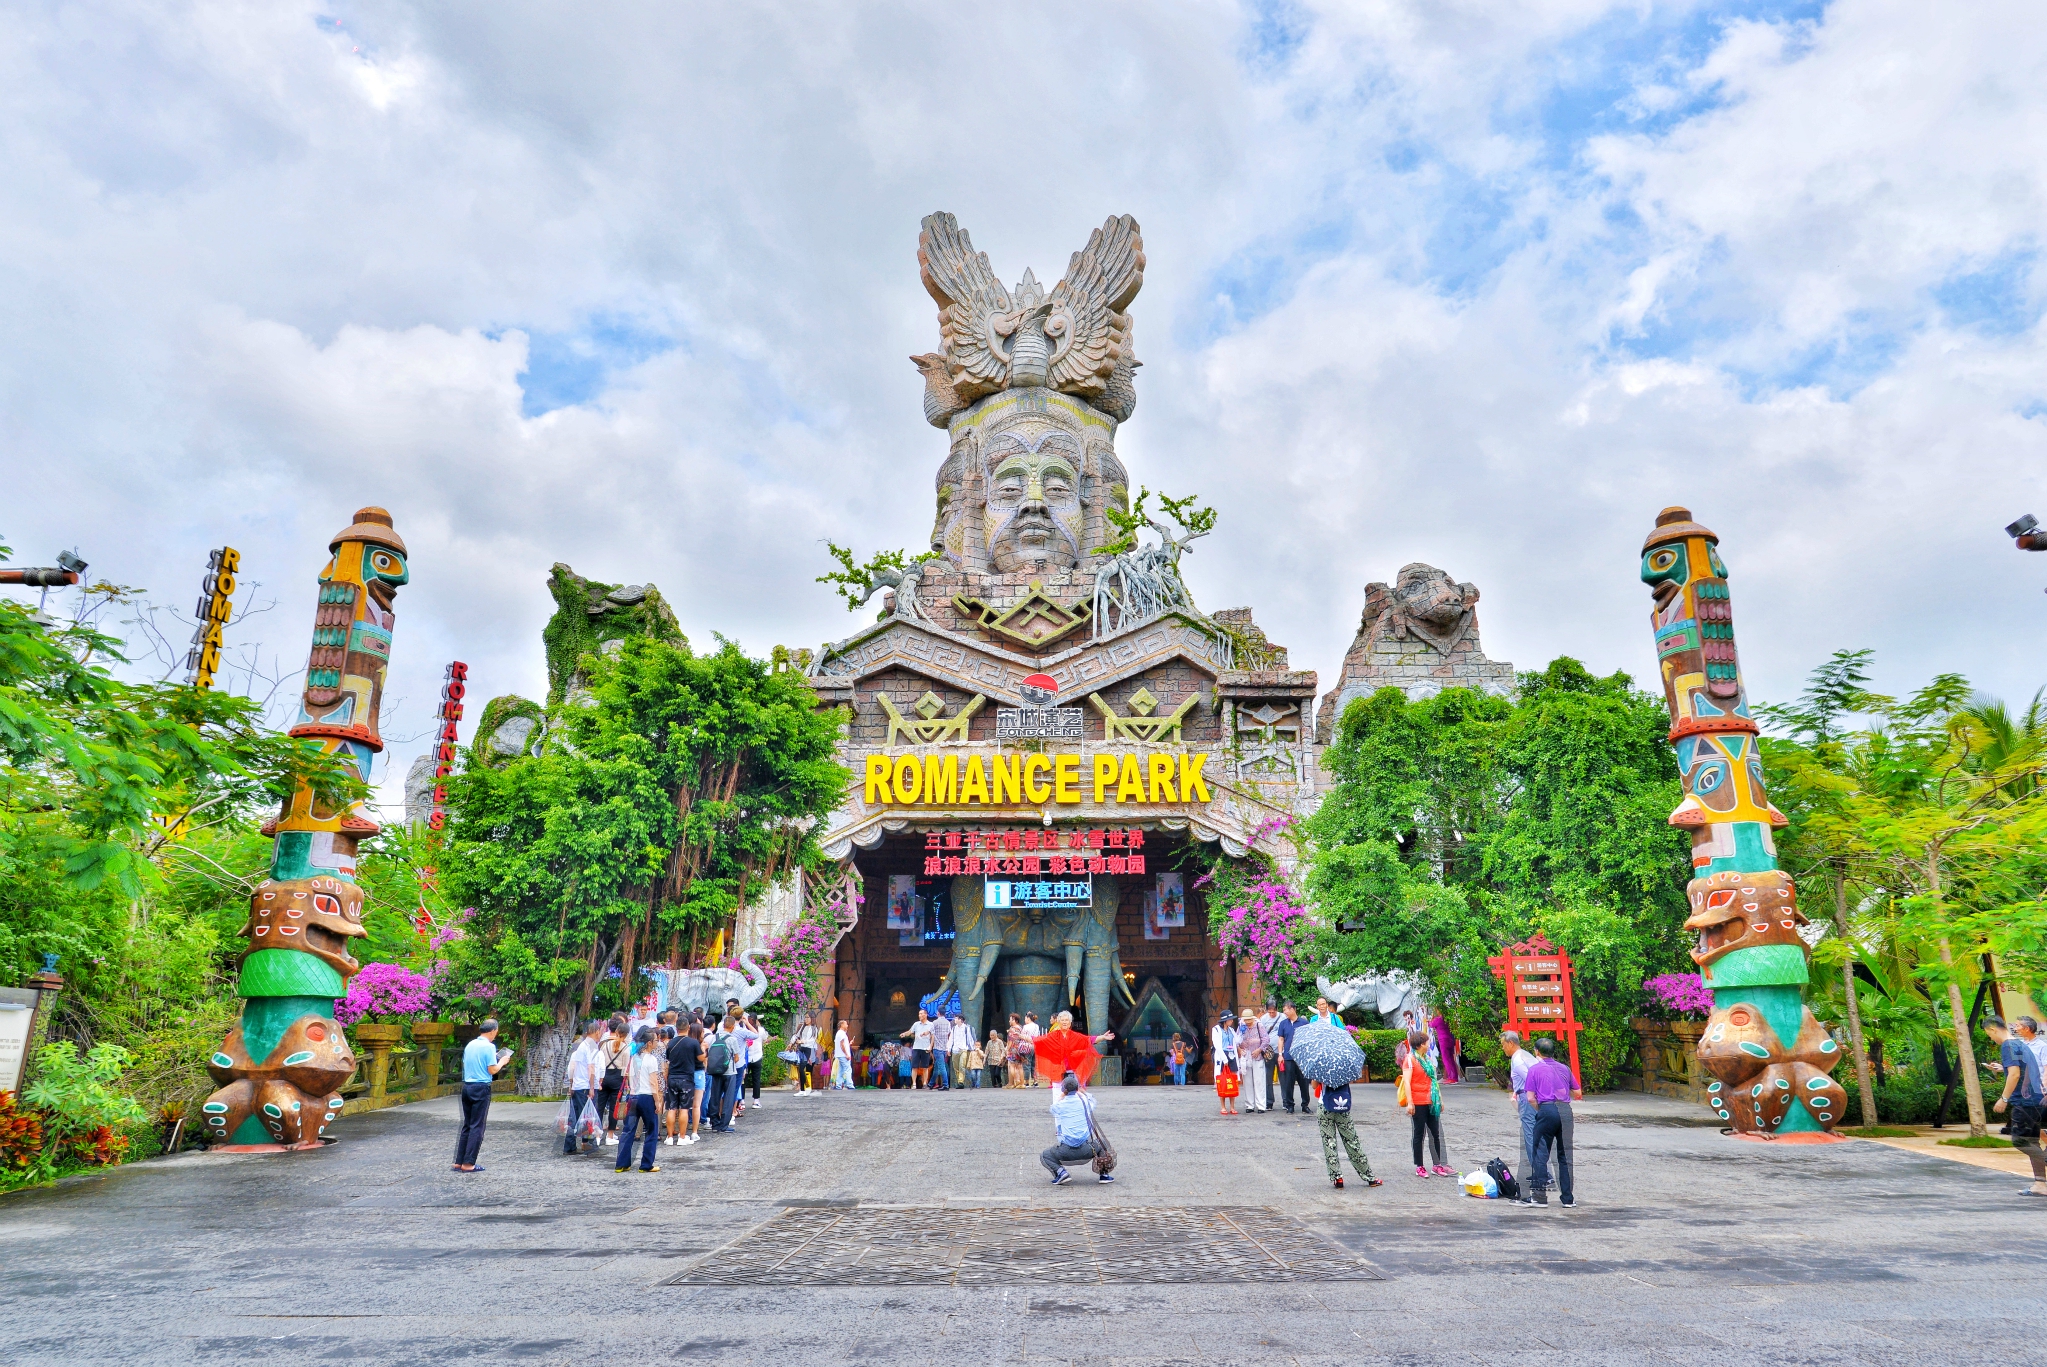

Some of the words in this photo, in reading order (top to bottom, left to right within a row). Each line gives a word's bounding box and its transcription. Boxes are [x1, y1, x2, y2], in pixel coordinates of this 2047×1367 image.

[997, 709, 1083, 727] 宋城演艺
[997, 728, 1083, 738] SONGCHENG
[865, 753, 1082, 805] ROMANCE
[1093, 752, 1212, 803] PARK
[924, 830, 1060, 851] 三亚千古情景区
[1069, 829, 1146, 851] 冰雪世界
[923, 855, 1041, 876] 浪浪浪水公园
[1048, 854, 1146, 876] 彩色动物园
[1013, 880, 1092, 901] 游客中心
[1024, 901, 1051, 909] Tourist
[1052, 901, 1078, 909] Center
